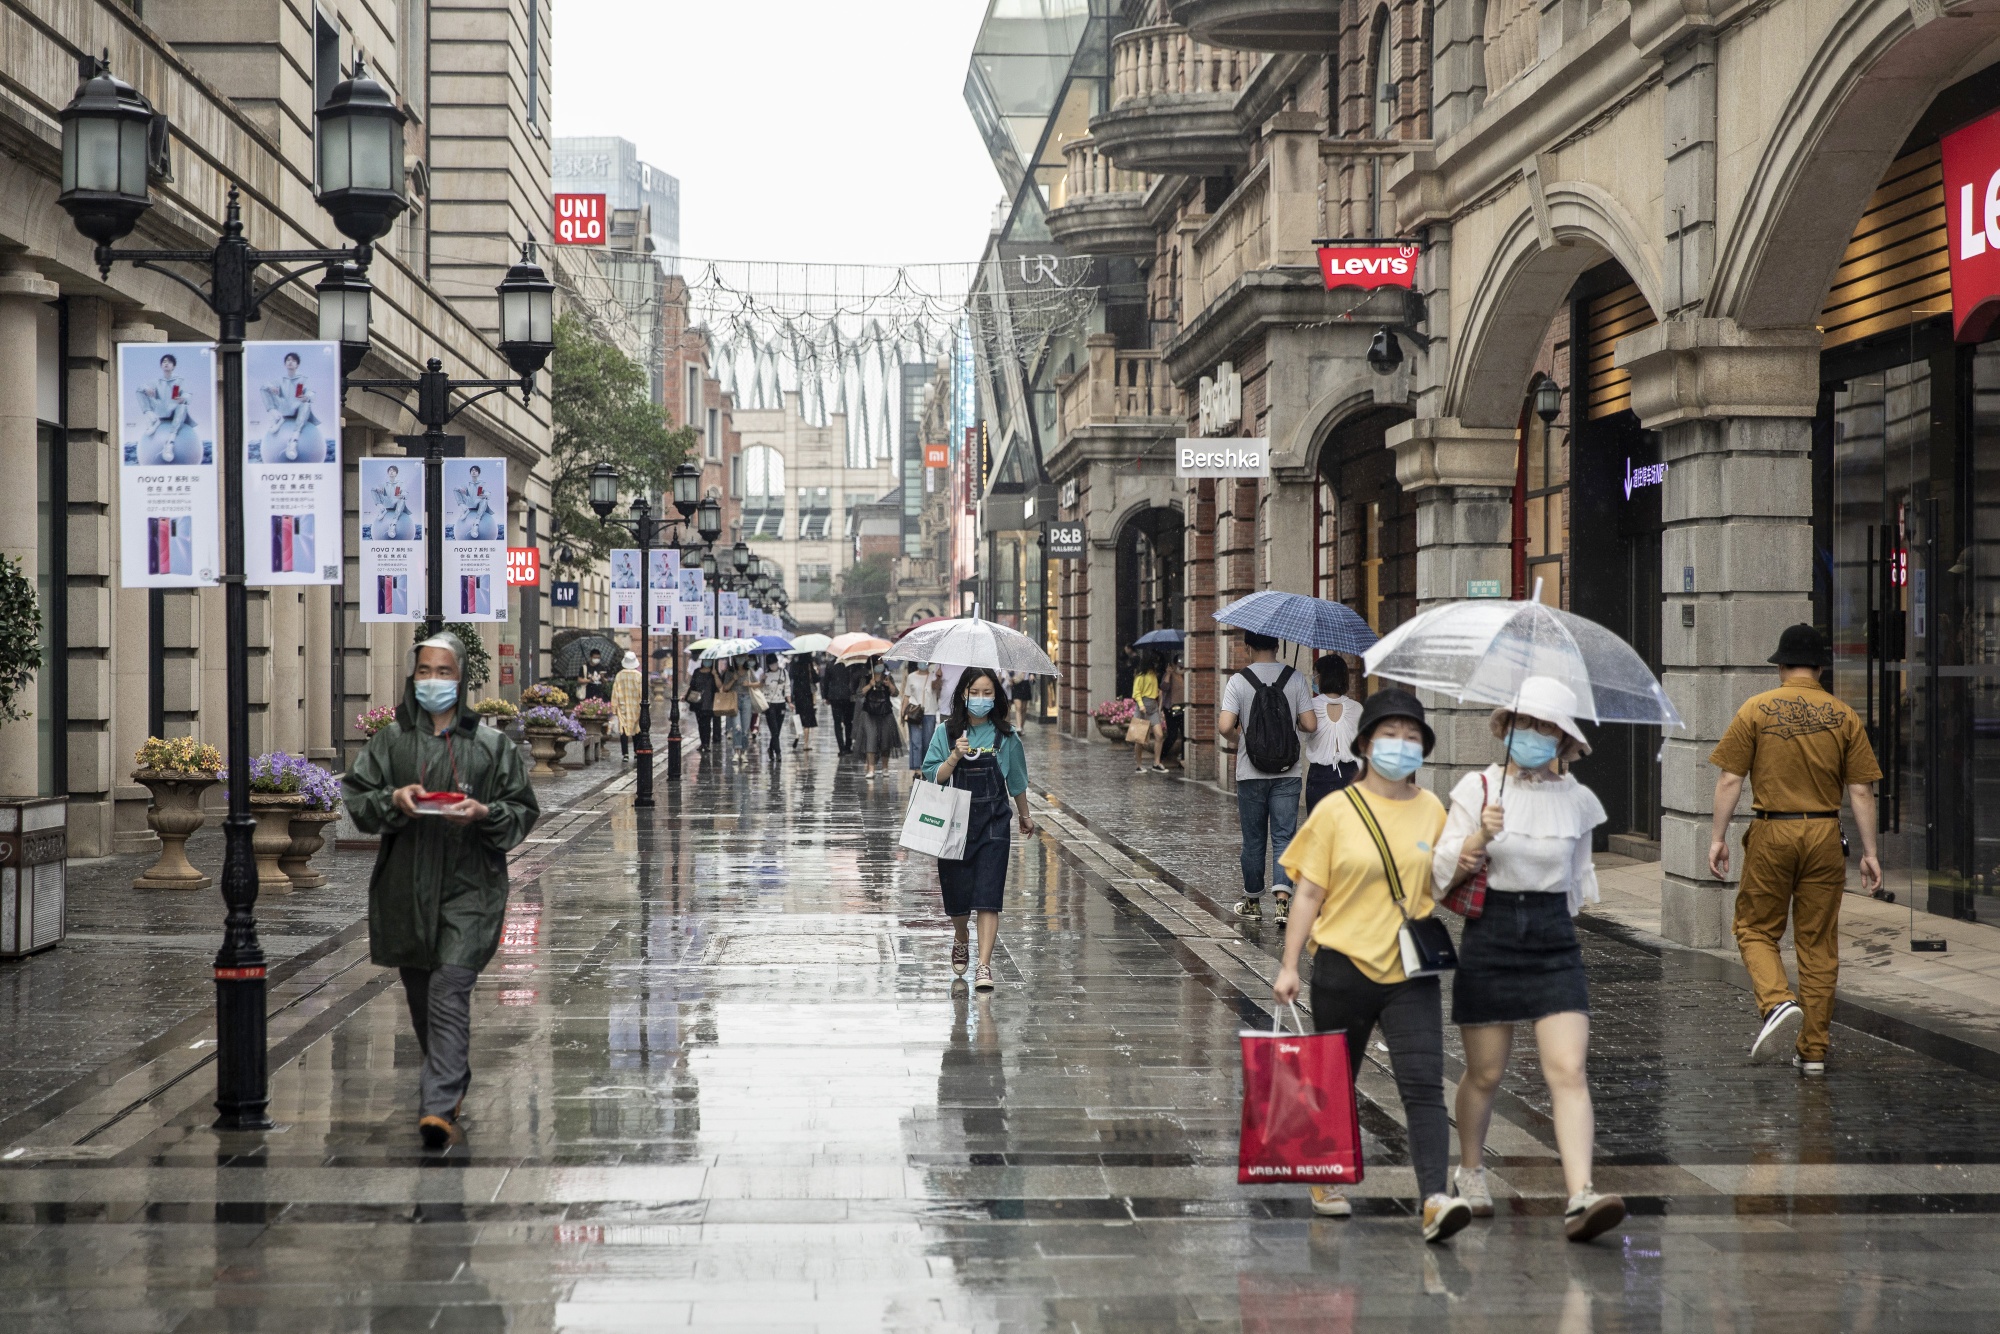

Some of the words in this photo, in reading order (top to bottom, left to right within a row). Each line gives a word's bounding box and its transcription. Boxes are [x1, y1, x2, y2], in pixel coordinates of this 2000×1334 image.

[559, 198, 597, 218] UNI
[560, 219, 600, 241] QLO
[1017, 253, 1064, 287] UR
[1181, 448, 1260, 469] Bershka
[1050, 528, 1082, 544] P&B
[507, 551, 533, 566] UNI
[507, 567, 535, 583] QLO
[557, 587, 574, 601] GAP
[1278, 1043, 1300, 1054] Disney
[1247, 1165, 1292, 1175] URBAN
[1296, 1163, 1344, 1175] REVIVO
